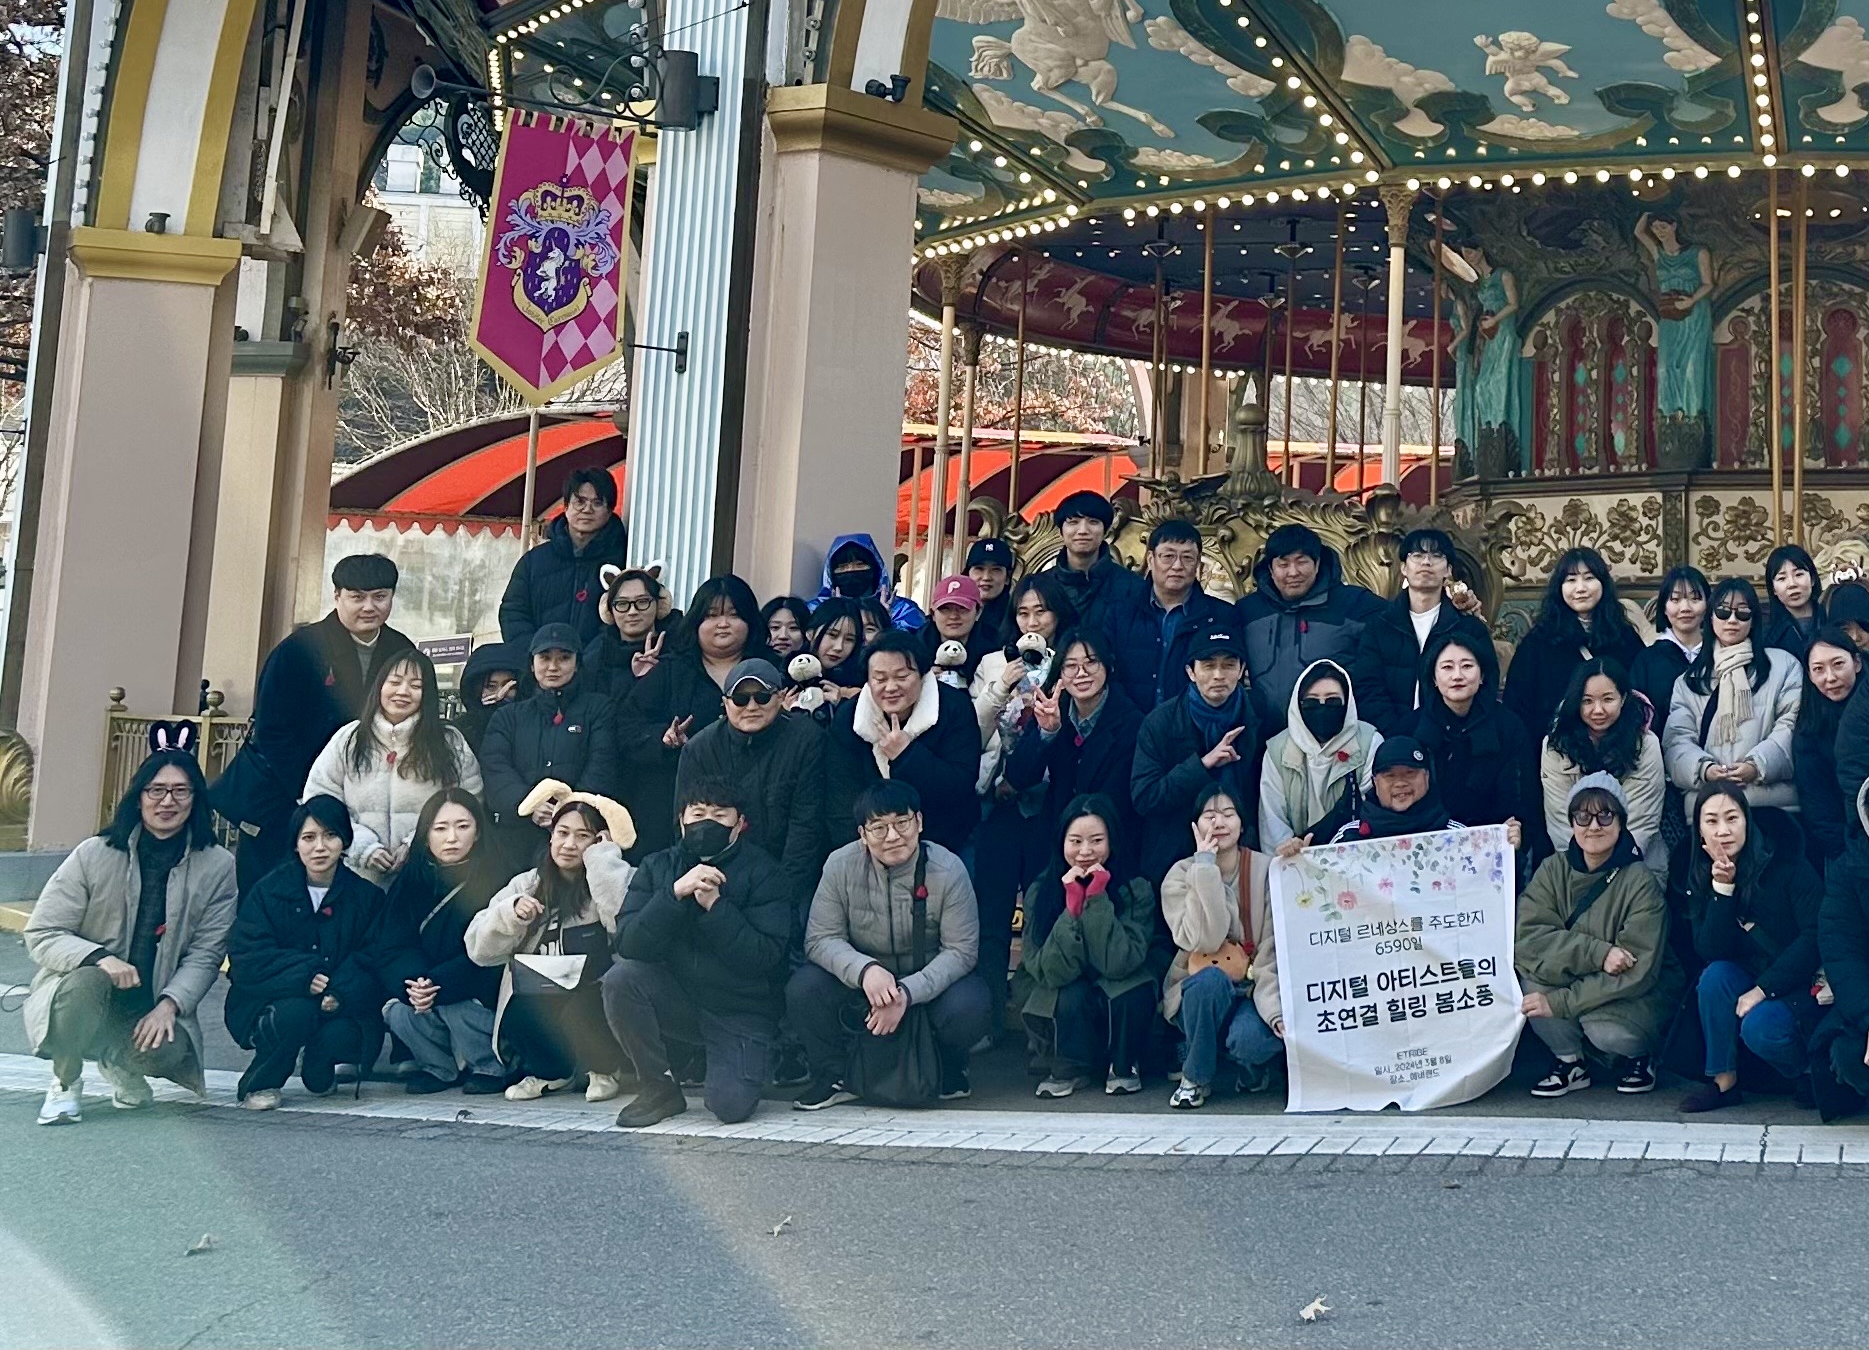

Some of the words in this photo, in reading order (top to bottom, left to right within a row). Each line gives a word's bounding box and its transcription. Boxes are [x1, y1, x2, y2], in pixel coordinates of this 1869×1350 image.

[1309, 926, 1352, 947] 디지털
[1356, 916, 1424, 940] 르네상스를
[1428, 909, 1486, 931] 주도한지
[1375, 936, 1424, 956] 6590일
[1306, 974, 1369, 1004] 디지털
[1376, 956, 1497, 992] 아티스트들의
[1317, 1002, 1380, 1033] 초연결
[1386, 994, 1428, 1023] 힐링
[1435, 983, 1494, 1015] 봄소풍
